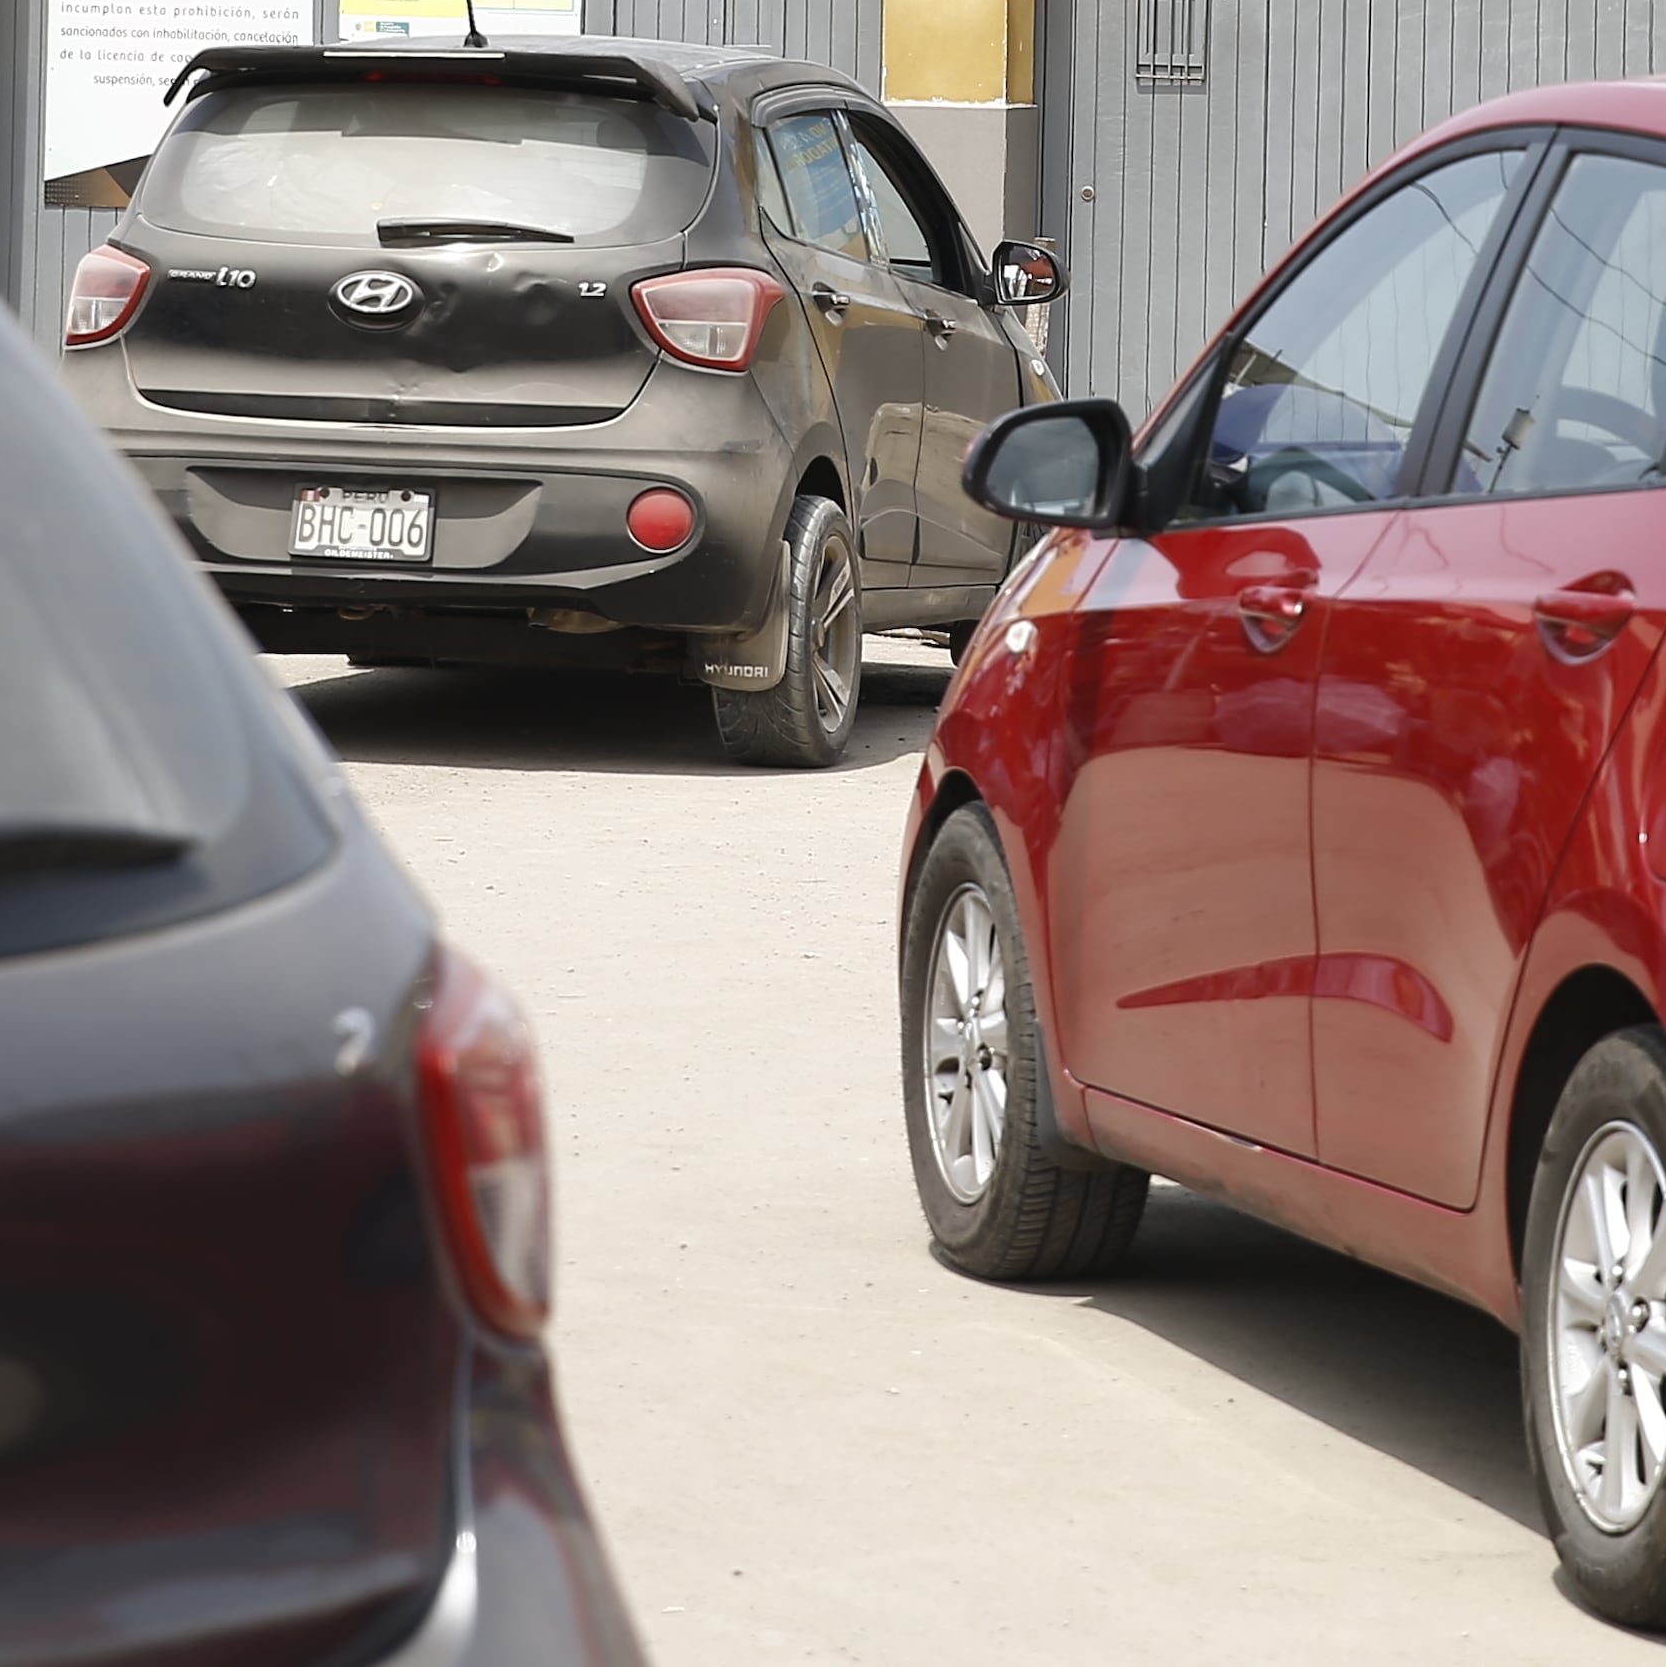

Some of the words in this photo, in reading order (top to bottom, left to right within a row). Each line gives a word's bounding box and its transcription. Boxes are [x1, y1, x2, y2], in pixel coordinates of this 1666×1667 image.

[61, 1, 132, 16] incumplan
[139, 4, 167, 16] esta
[173, 6, 255, 20] prohibición,
[262, 7, 299, 20] serán
[60, 26, 128, 38] sancionados
[131, 29, 150, 38] con
[153, 27, 231, 43] inhabilitación,
[59, 48, 74, 60] de
[79, 49, 91, 60] la
[98, 49, 145, 62] licencia
[151, 51, 165, 62] de
[93, 73, 155, 87] suspensión,
[216, 266, 256, 288] i10
[298, 503, 423, 548] BHC-006
[704, 664, 768, 678] HYUNDAI
